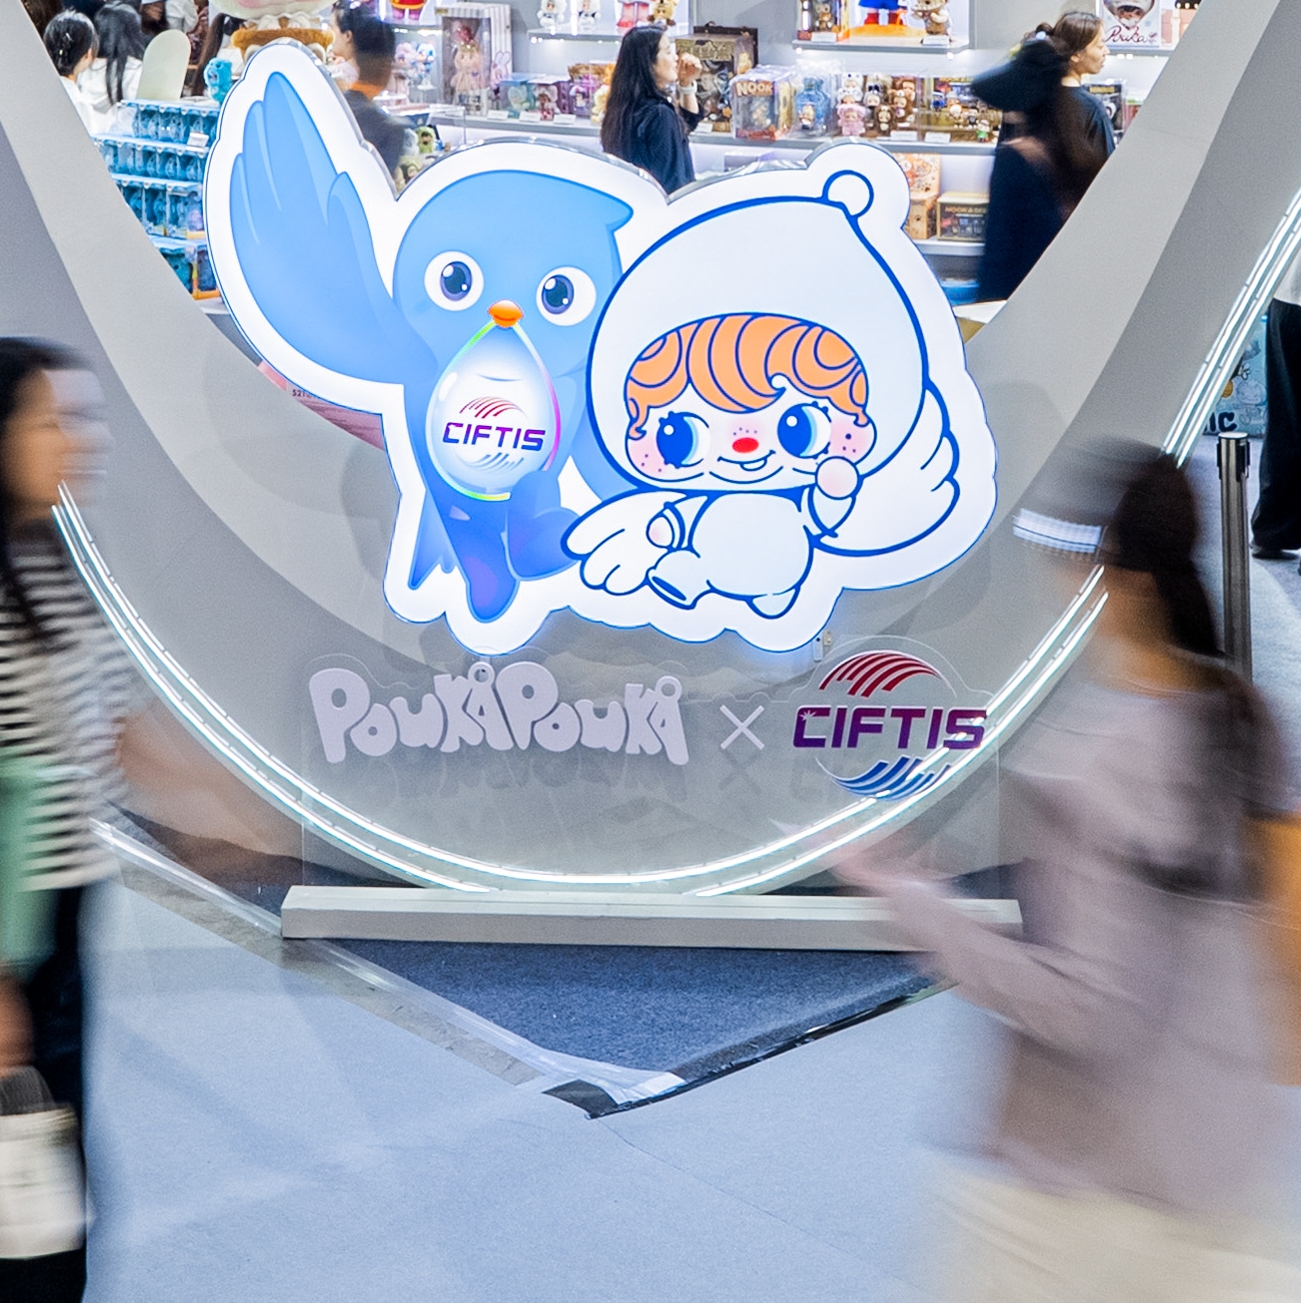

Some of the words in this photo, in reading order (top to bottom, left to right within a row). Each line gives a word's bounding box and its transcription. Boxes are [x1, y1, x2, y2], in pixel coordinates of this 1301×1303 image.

[736, 80, 774, 96] NOOK
[442, 422, 546, 452] CIFTIS
[792, 704, 989, 751] CIFTIS
